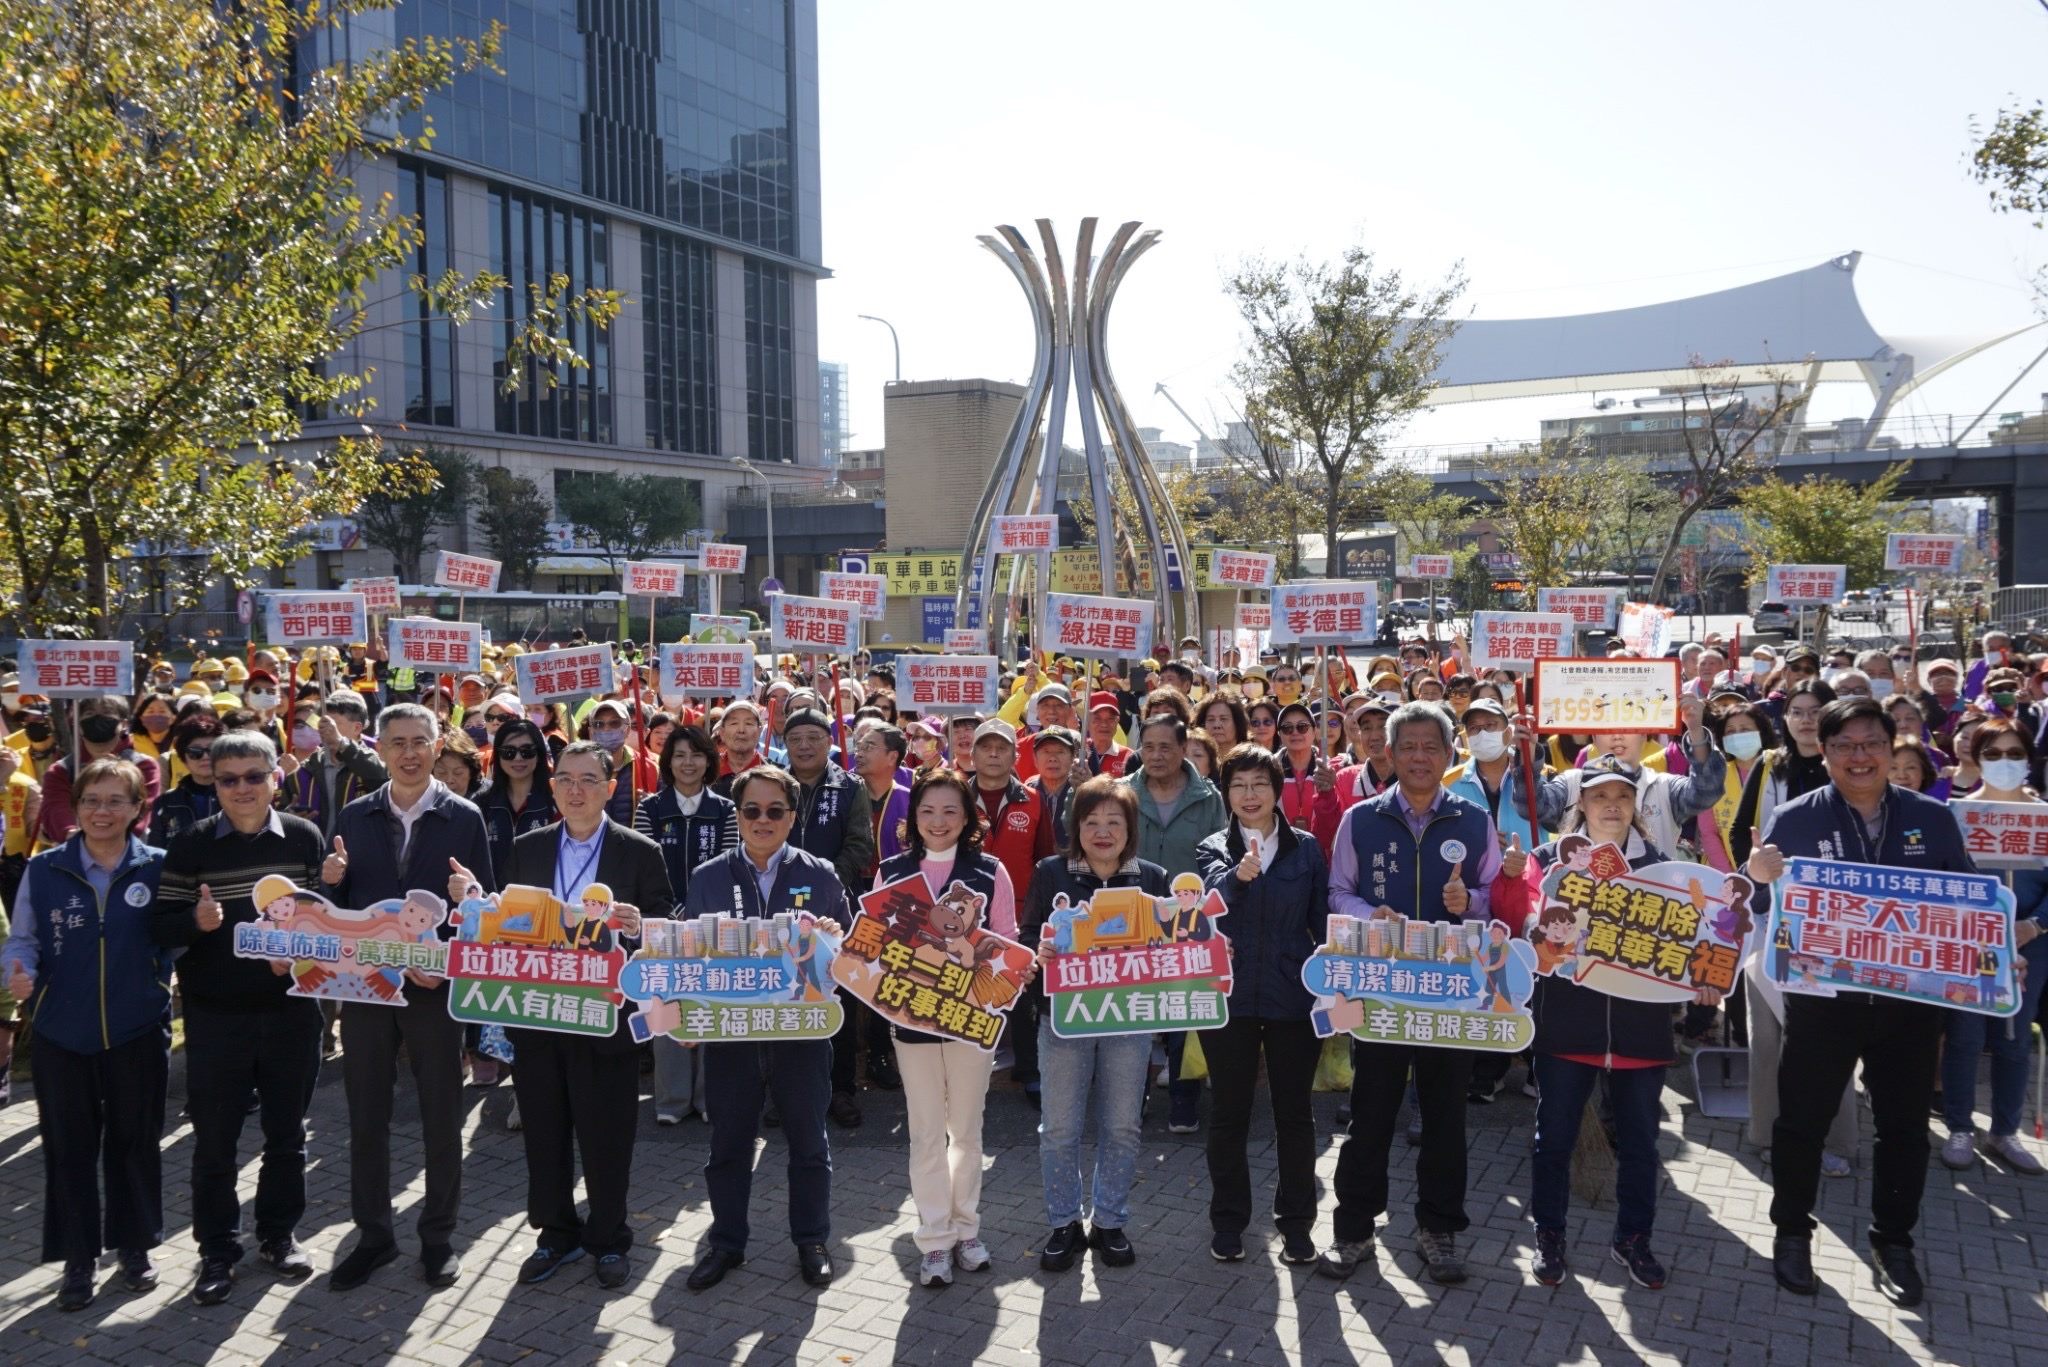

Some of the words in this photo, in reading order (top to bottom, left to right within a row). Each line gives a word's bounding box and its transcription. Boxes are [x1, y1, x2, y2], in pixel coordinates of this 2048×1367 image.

[1001, 521, 1051, 530] 臺北市萬華區
[1002, 532, 1050, 547] 新和里
[706, 556, 740, 569] 騰雲里
[874, 560, 956, 579] 萬華車站
[1220, 556, 1268, 568] 臺北市萬華區
[447, 568, 490, 588] 日祥里
[632, 576, 676, 592] 忠貞里
[1220, 566, 1265, 583] 凌霄里
[1285, 592, 1365, 608] 臺北市萬華區
[1548, 594, 1608, 604] 臺北市萬華區
[1780, 582, 1834, 598] 保德里
[279, 602, 354, 614] 臺北市萬華區
[783, 604, 848, 622] 臺北市萬華區
[1060, 604, 1142, 624] 臺北市萬華區
[283, 616, 354, 636] 西門里
[784, 619, 846, 646] 新起里
[1288, 608, 1362, 634] 孝德里
[1486, 621, 1562, 635] 臺北市萬華區
[401, 628, 472, 642] 臺北市萬華區
[1060, 620, 1136, 650] 綠堤里
[34, 649, 120, 662] 臺北市萬華區
[404, 641, 469, 664] 福星里
[672, 652, 744, 664] 臺北市萬華區
[1488, 636, 1558, 659] 錦德里
[528, 652, 602, 674] 臺北市萬華區
[910, 664, 987, 678] 臺北市萬華區
[37, 664, 118, 687] 富民里
[533, 666, 602, 695] 萬壽里
[674, 666, 742, 688] 菜園里
[912, 680, 985, 704] 富福里
[1966, 812, 2048, 828] 臺北市萬華
[1388, 842, 1400, 872] 署長
[1594, 852, 1616, 875] 春
[1800, 864, 1989, 901] 臺北市115年萬華區
[66, 895, 85, 929] 主任
[1558, 873, 1700, 936] 年終掃除
[1784, 886, 2004, 946] 年終大掃除
[238, 926, 341, 962] 除舊佈新
[1585, 918, 1740, 990] 萬華有福
[1800, 921, 1979, 977] 誓師活動
[460, 948, 610, 984] 垃圾不落地
[842, 916, 974, 998] 馬年一到
[1058, 944, 1212, 988] 垃圾不落地
[639, 962, 782, 993] 清潔動起來
[1324, 959, 1471, 997] 清潔動起來
[460, 981, 609, 1030] 人人有福氣
[878, 974, 1002, 1046] 好事報到
[1064, 990, 1220, 1023] 人人有福氣
[686, 1007, 828, 1038] 幸福跟著來
[1368, 1008, 1518, 1043] 幸福跟著來
